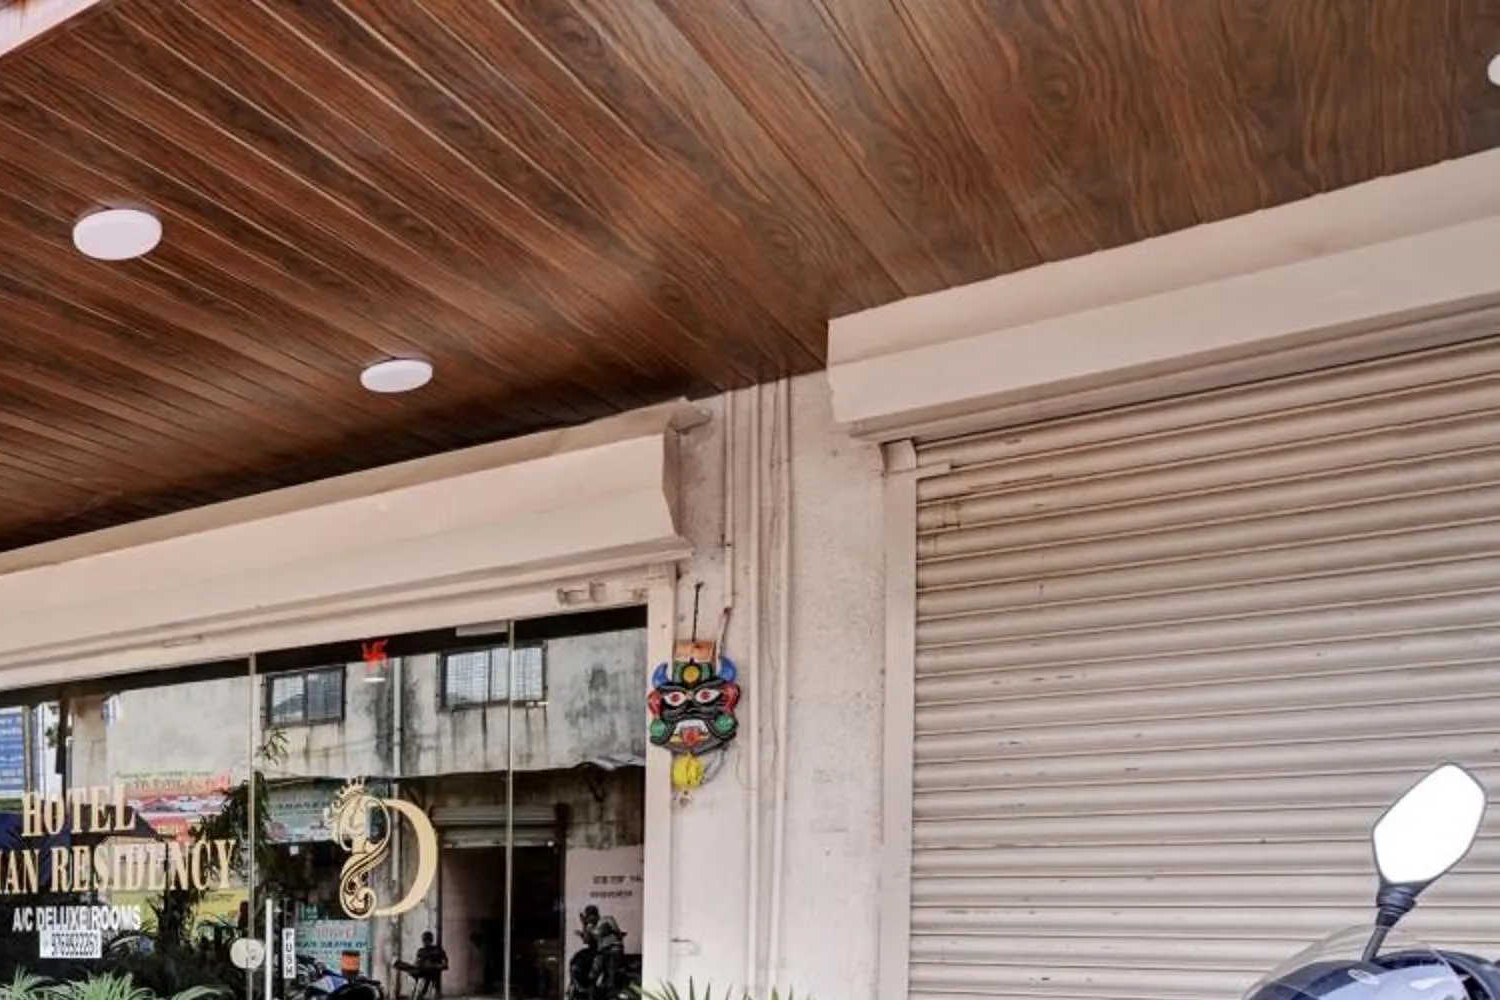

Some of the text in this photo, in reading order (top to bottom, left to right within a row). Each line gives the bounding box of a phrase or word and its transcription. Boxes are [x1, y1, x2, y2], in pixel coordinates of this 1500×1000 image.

[20, 783, 136, 838] HOTEL
[50, 838, 238, 894] RESIDENCY
[11, 904, 142, 932] A/C DELUXE ROOMS
